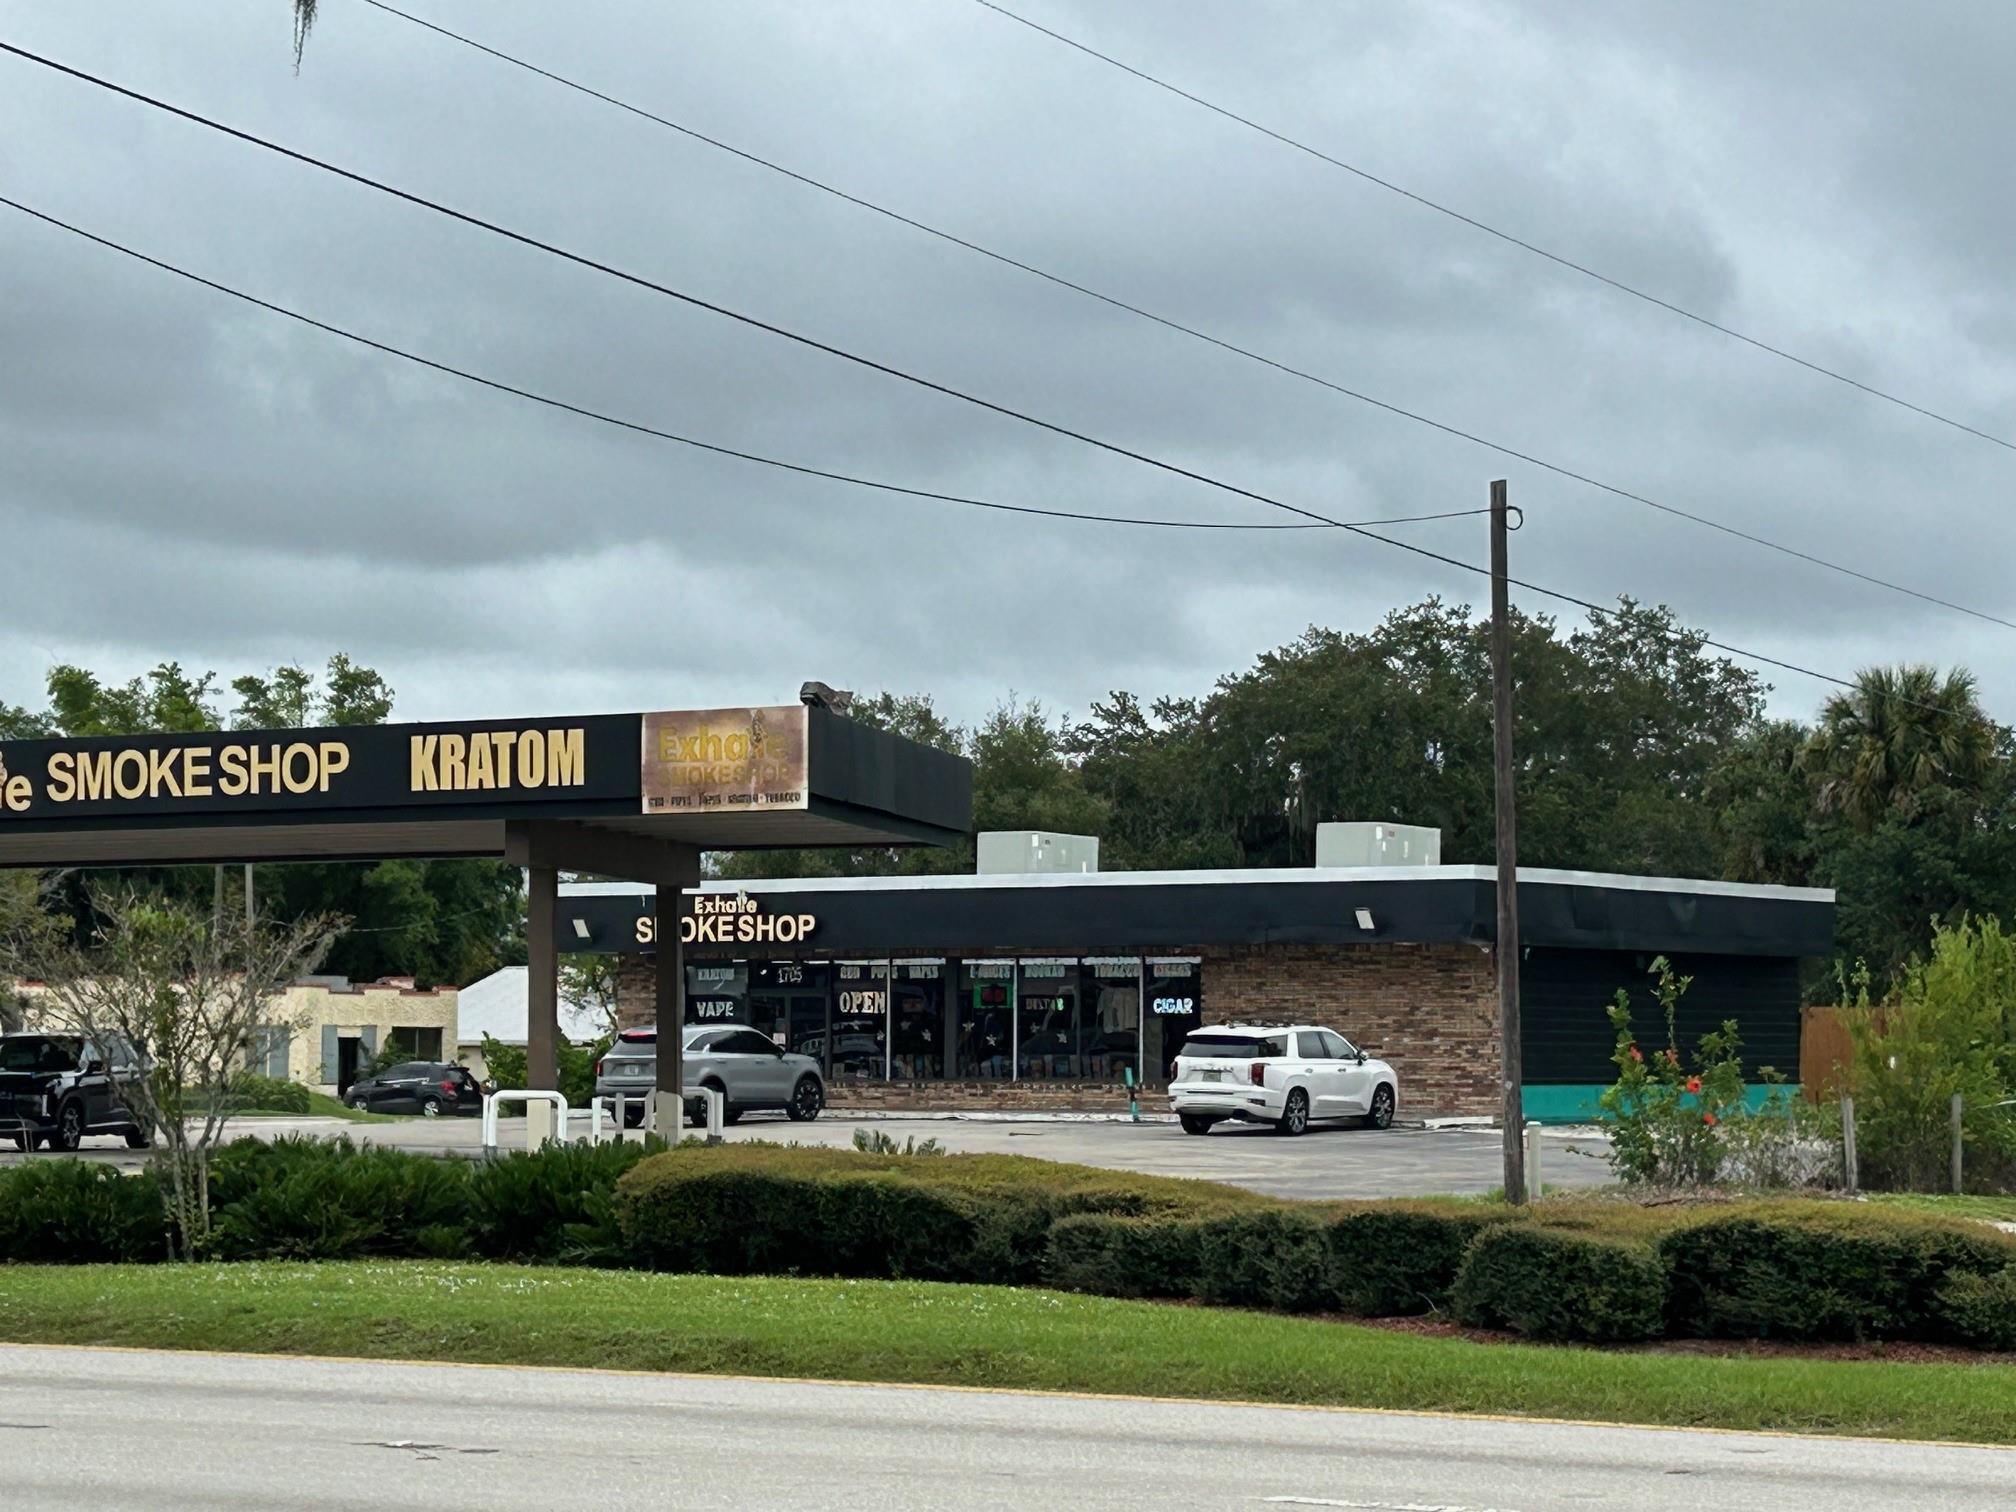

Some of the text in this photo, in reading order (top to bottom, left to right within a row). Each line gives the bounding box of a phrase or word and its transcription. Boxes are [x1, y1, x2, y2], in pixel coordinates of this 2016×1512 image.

[47, 747, 213, 802] SMOKE
[219, 742, 350, 796] SHOP
[410, 729, 585, 791] KRATOM
[635, 914, 816, 943] SOKESHOP
[696, 1001, 734, 1018] VAPE
[839, 991, 886, 1014] OPEN
[1153, 997, 1193, 1014] CIGAR
